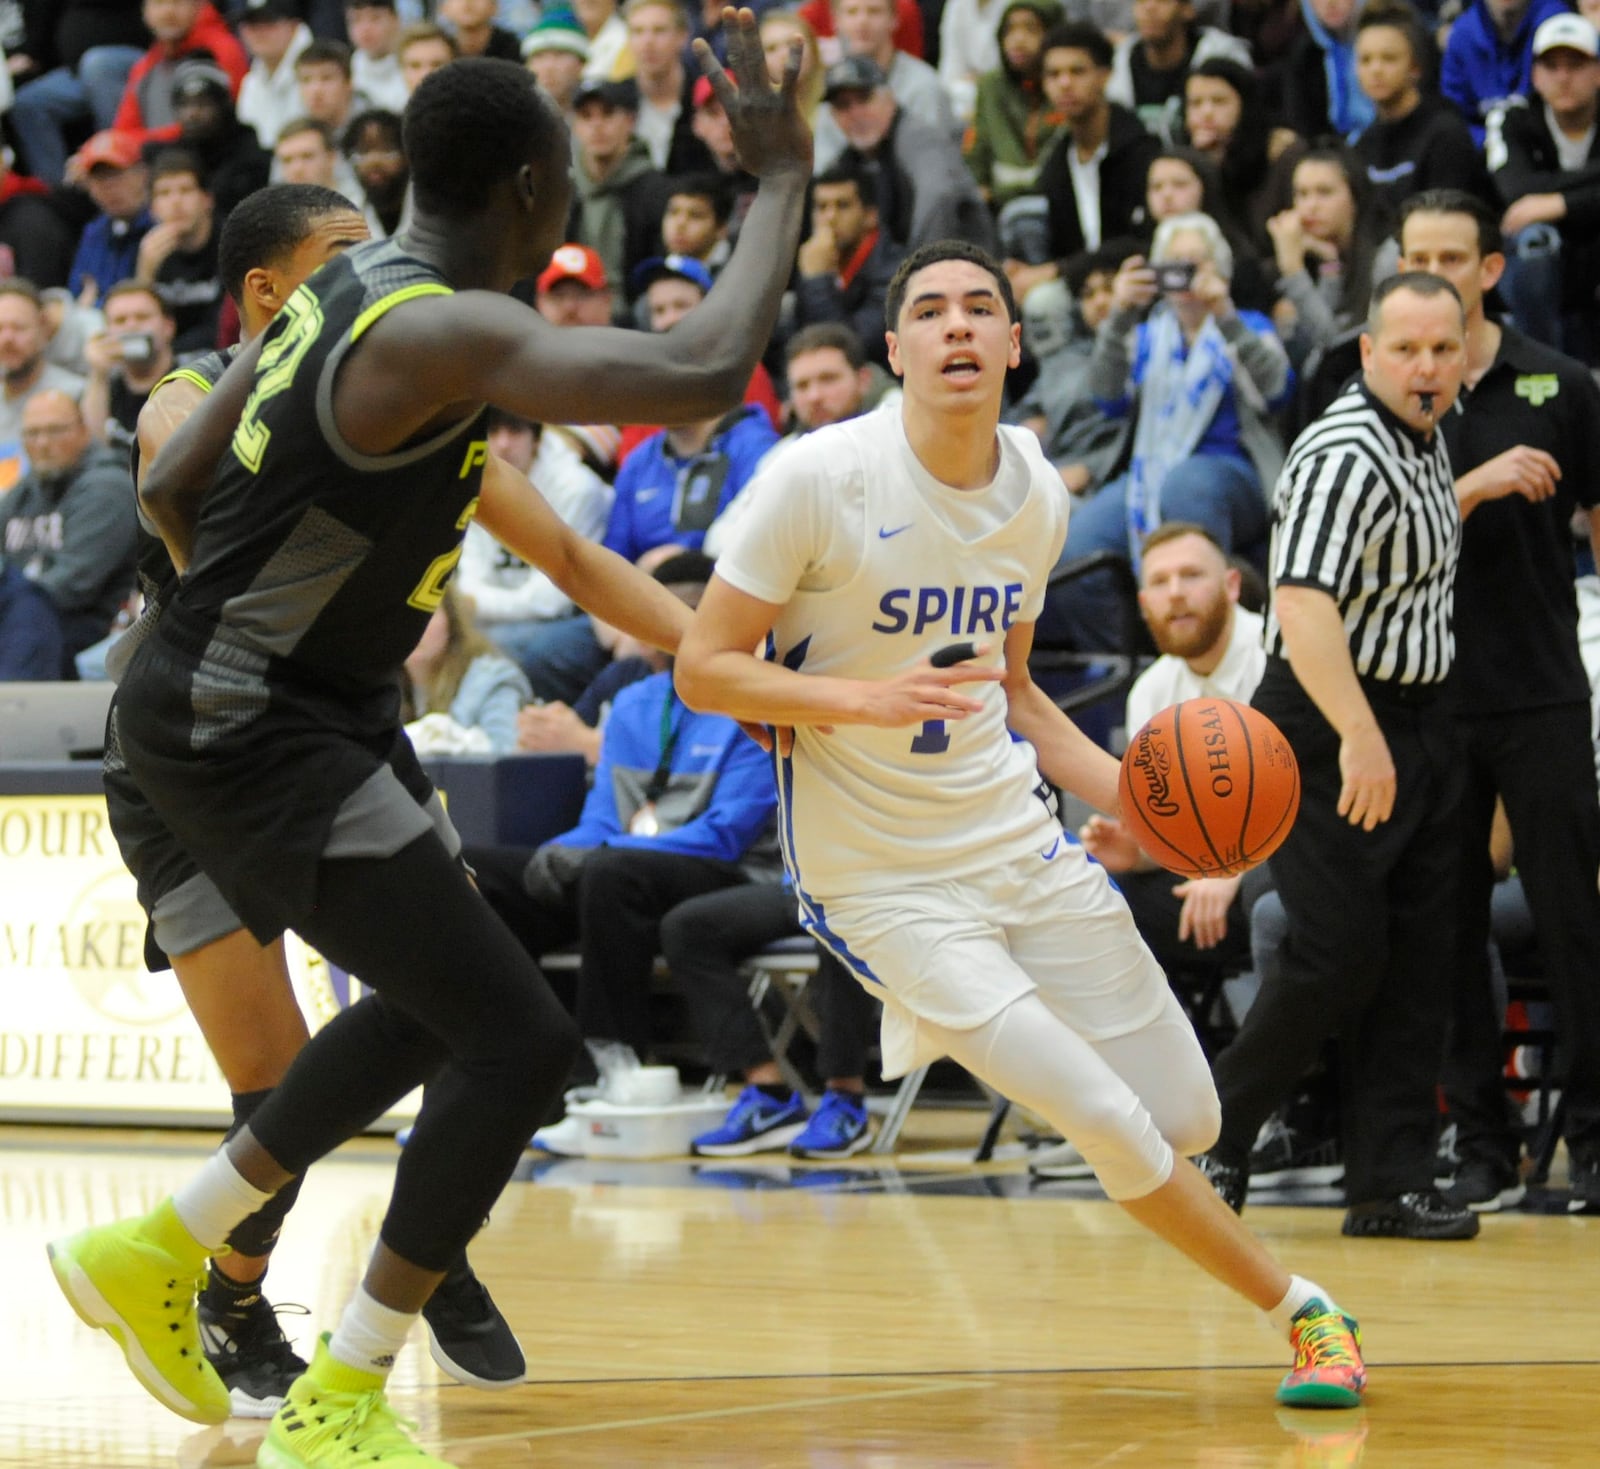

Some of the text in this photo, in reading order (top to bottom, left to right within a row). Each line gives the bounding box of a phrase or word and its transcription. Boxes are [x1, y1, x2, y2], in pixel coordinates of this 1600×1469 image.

[872, 583, 1023, 635] SPIRE
[1134, 728, 1180, 817] Rawling
[1198, 705, 1233, 798] OHSAA
[0, 808, 104, 857] OUR
[0, 920, 142, 970] MAKE
